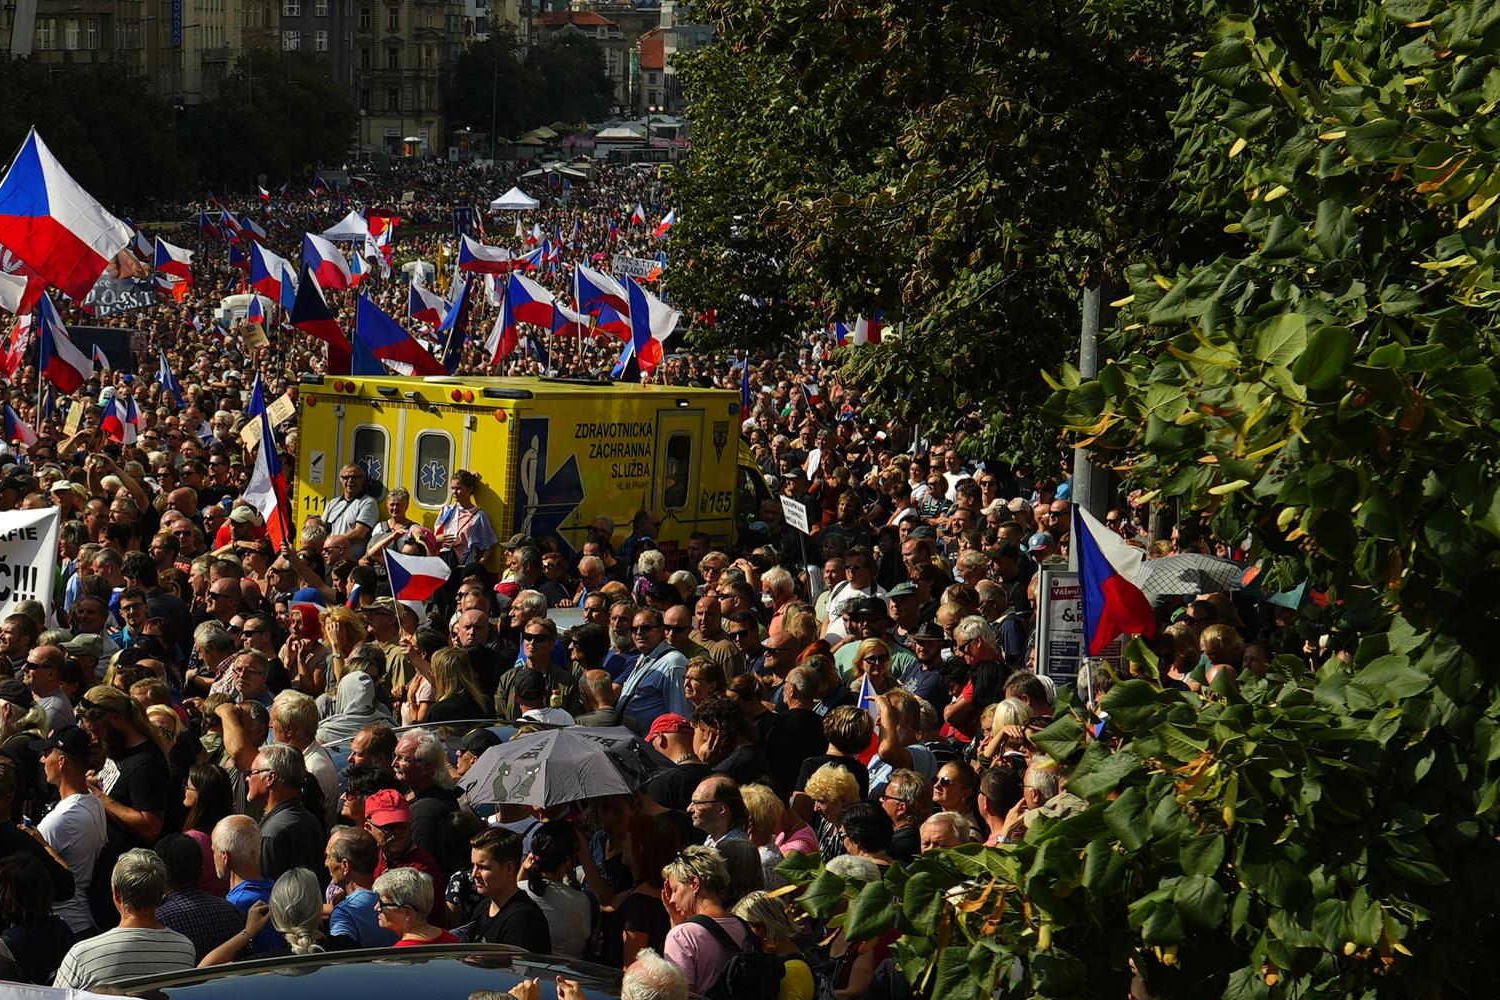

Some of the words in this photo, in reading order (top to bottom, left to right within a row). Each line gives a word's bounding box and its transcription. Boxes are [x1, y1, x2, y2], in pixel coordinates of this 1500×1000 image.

[173, 0, 181, 46] OKOKO
[575, 418, 652, 439] ZDRAVOTNICKÁ
[589, 438, 651, 459] ZÁCHRANNÁ
[611, 459, 650, 478] SLUŽBA
[709, 491, 733, 513] 155
